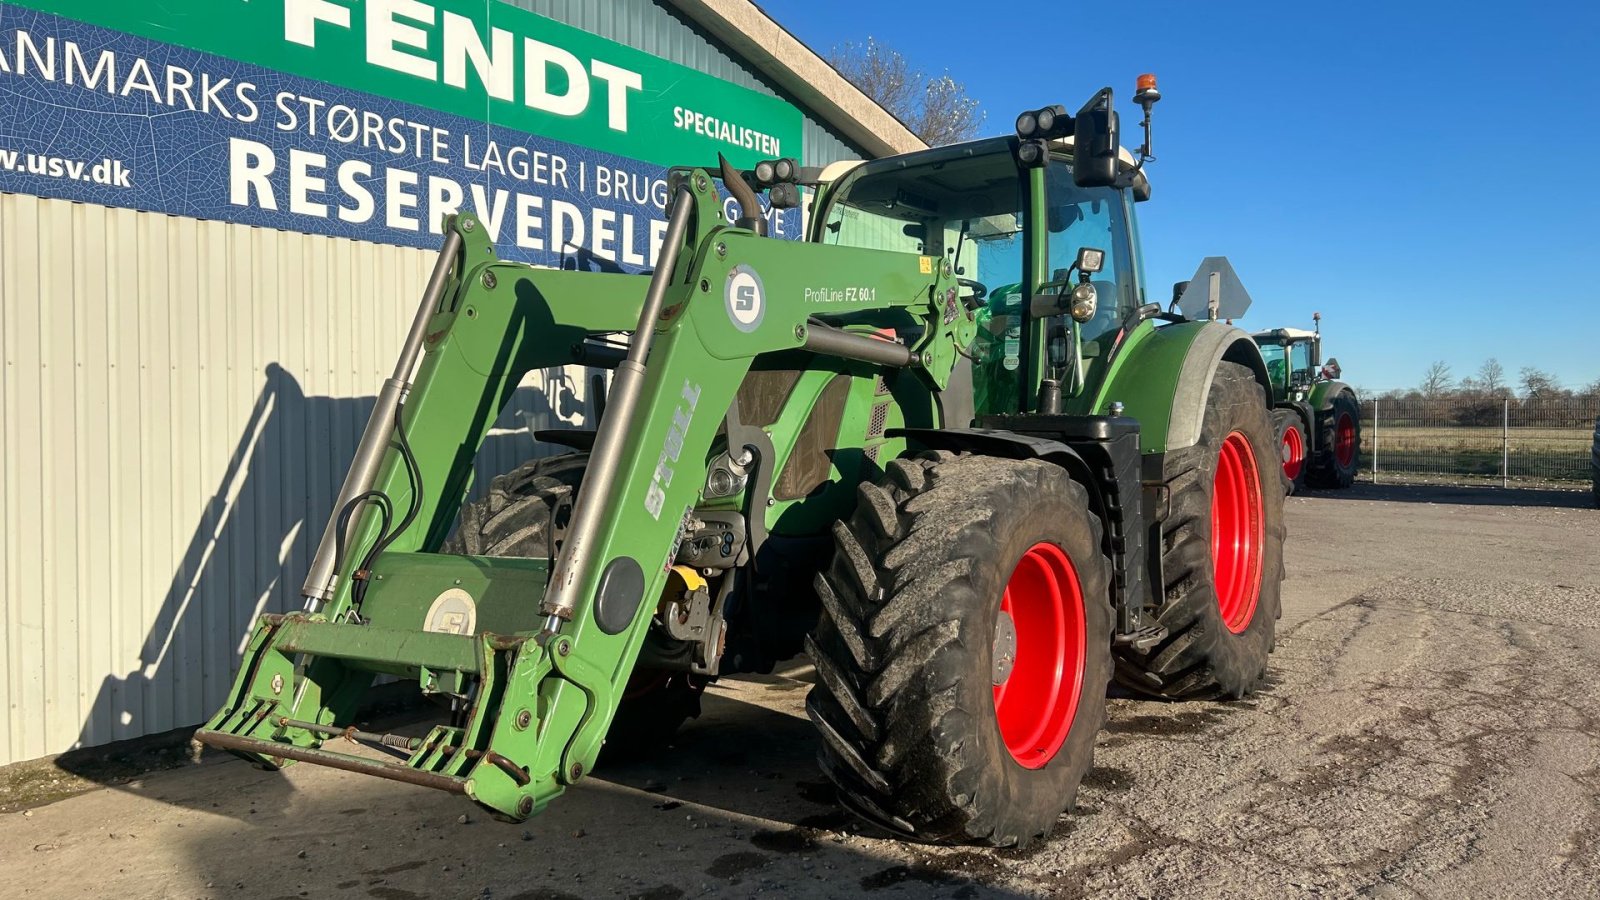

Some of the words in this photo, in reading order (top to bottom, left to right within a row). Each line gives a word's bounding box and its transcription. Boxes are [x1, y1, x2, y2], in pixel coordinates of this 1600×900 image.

[0, 30, 259, 122] NMARKS
[276, 91, 449, 163] STØRSTE
[464, 134, 568, 189] LAGER
[580, 162, 585, 191] I
[596, 165, 667, 209] BRUG
[760, 205, 785, 235] YE
[673, 106, 780, 157] SPECIALISTEN
[804, 287, 843, 302] ProfiLine
[845, 287, 857, 302] FZ
[859, 287, 875, 302] 60.1
